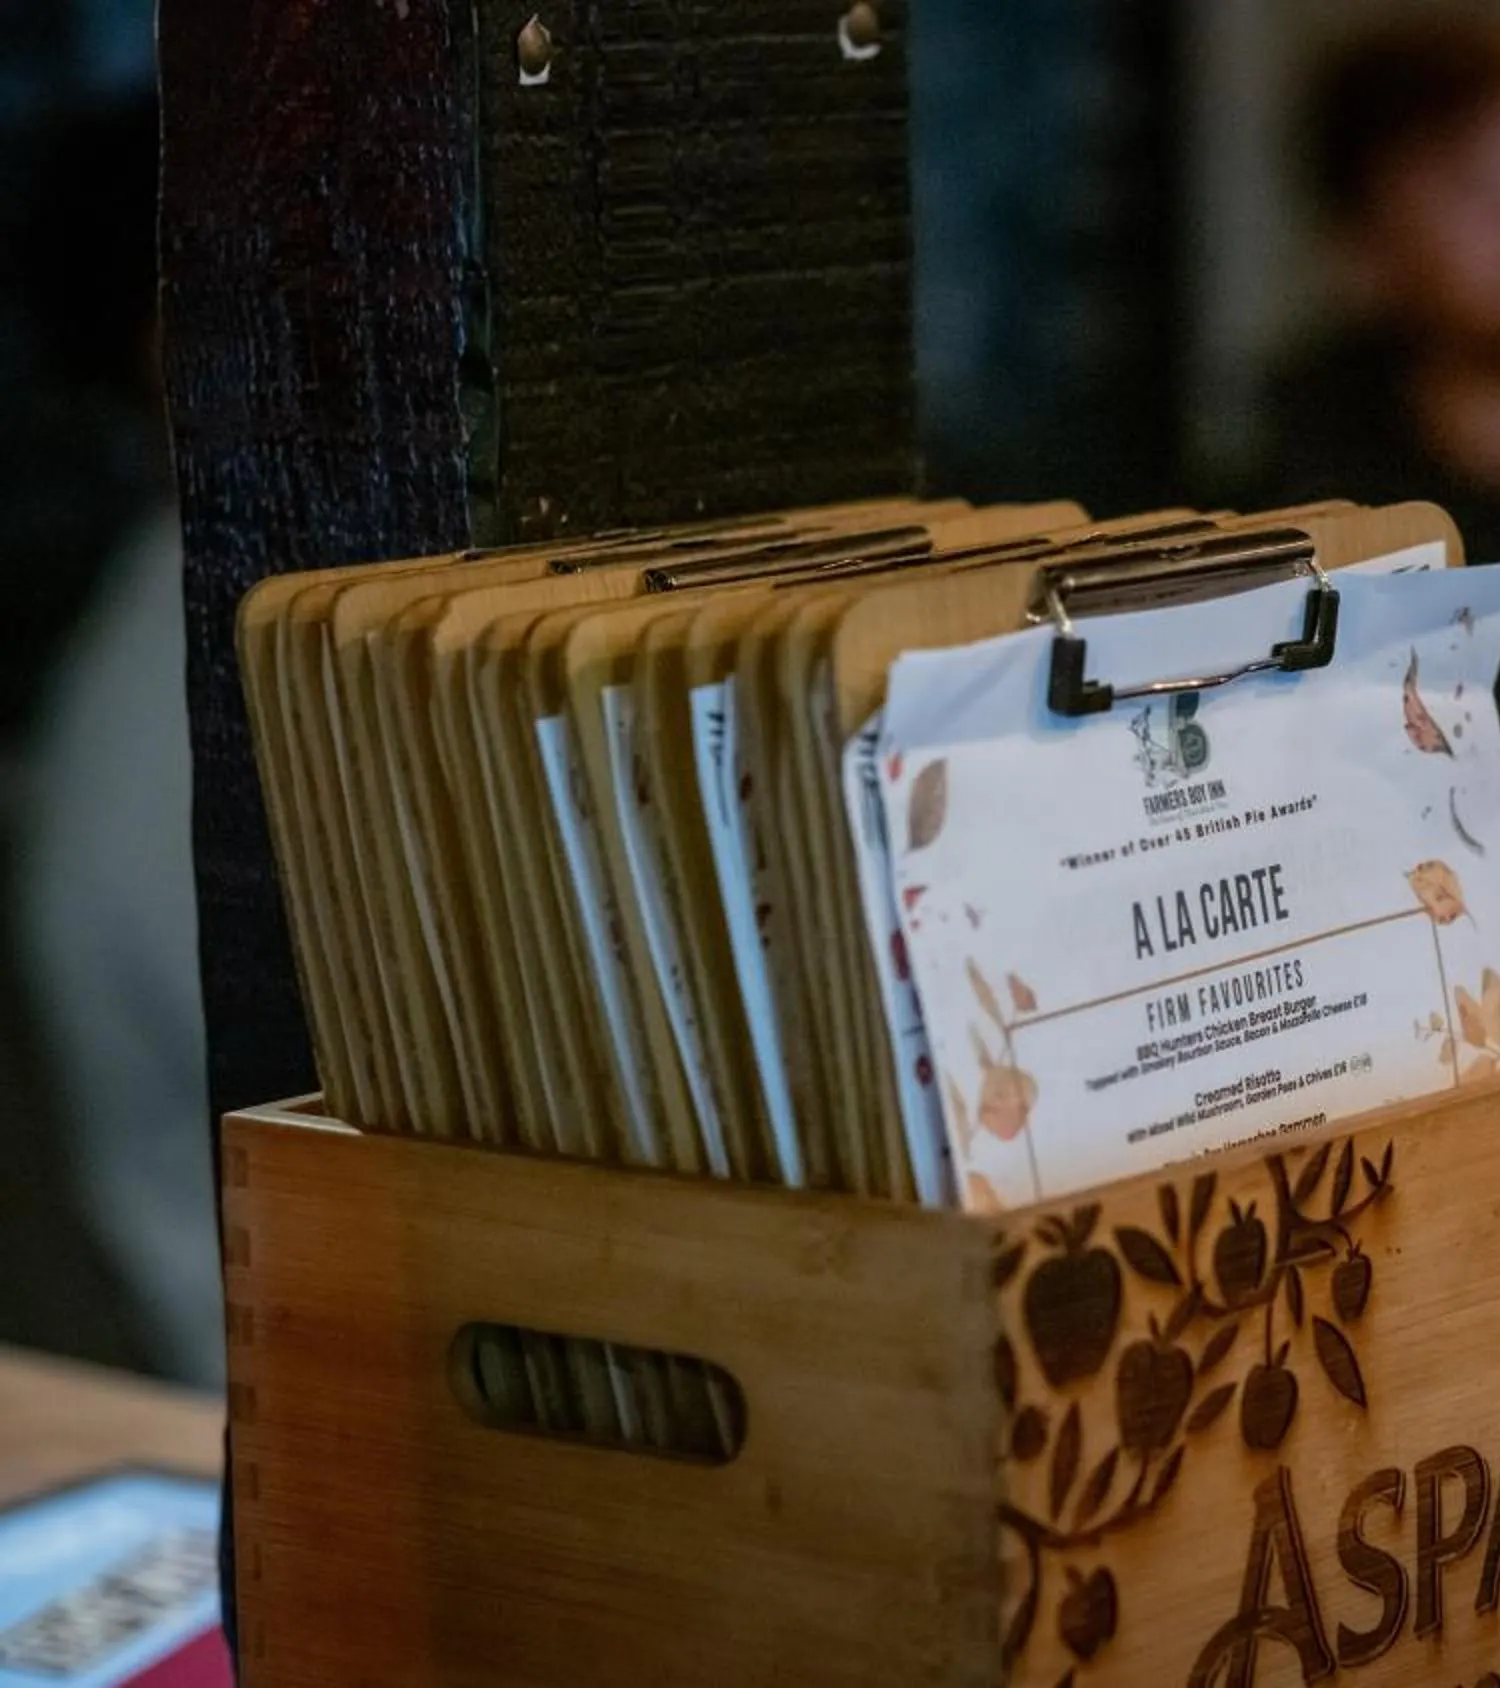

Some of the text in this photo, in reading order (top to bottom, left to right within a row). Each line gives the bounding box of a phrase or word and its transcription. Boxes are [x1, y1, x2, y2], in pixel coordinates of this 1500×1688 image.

[1121, 843, 1135, 857] of
[1139, 834, 1171, 852] Over
[1195, 815, 1241, 838] British
[1245, 808, 1266, 825] Pie
[1270, 793, 1318, 819] Awards"
[1142, 788, 1188, 815] FARMERS
[1187, 783, 1207, 805] BOY
[1132, 864, 1289, 960] A LA CARTE
[1146, 959, 1304, 1032] FIRM FAVOURITES
[1137, 995, 1317, 1061] BBQ Hunters Chicken Breast Burger
[1178, 1044, 1213, 1063] Bourbon
[1244, 1026, 1270, 1042] Bacon
[1322, 1000, 1352, 1017] Cheese
[1195, 1069, 1281, 1106] Creamed Risotto
[1246, 1087, 1276, 1104] Garden
[1278, 1079, 1297, 1096] Peas
[1306, 1068, 1333, 1086] Chives
